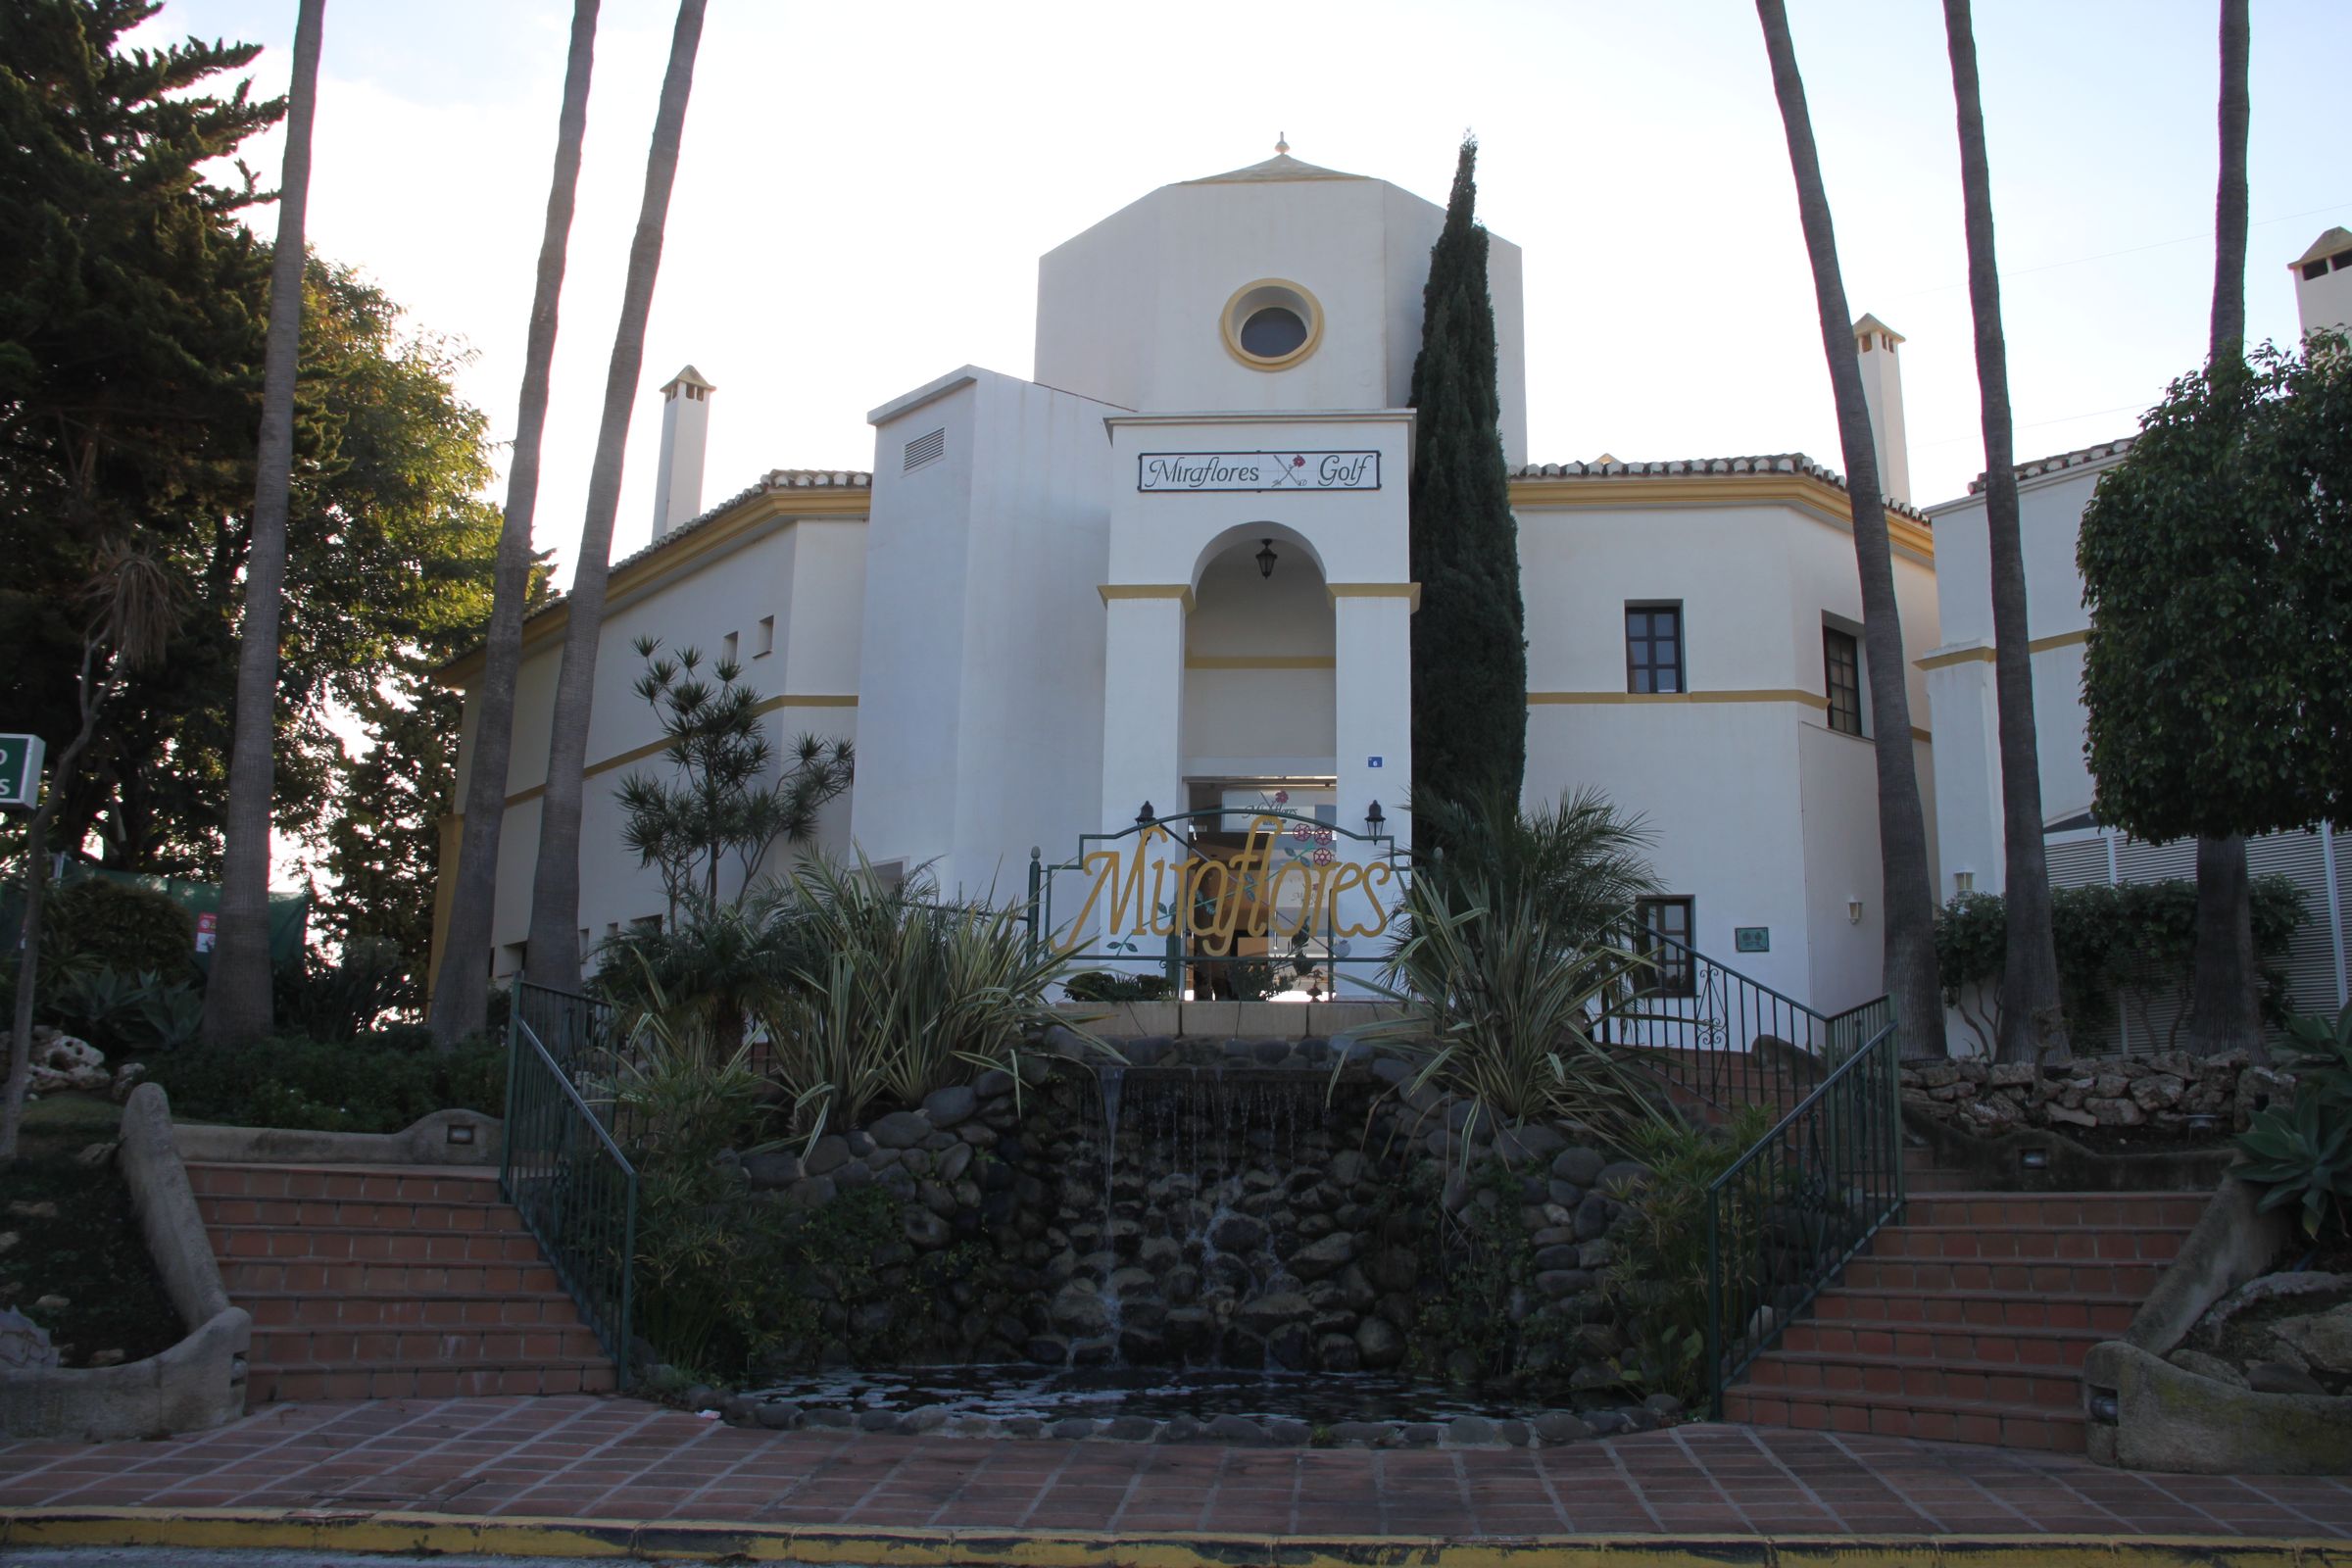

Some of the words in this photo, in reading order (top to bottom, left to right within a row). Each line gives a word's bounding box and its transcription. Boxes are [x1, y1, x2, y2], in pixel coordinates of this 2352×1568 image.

[1145, 457, 1259, 488] Miraflores
[1317, 455, 1374, 487] Golf
[1049, 814, 1391, 957] Miraflores
